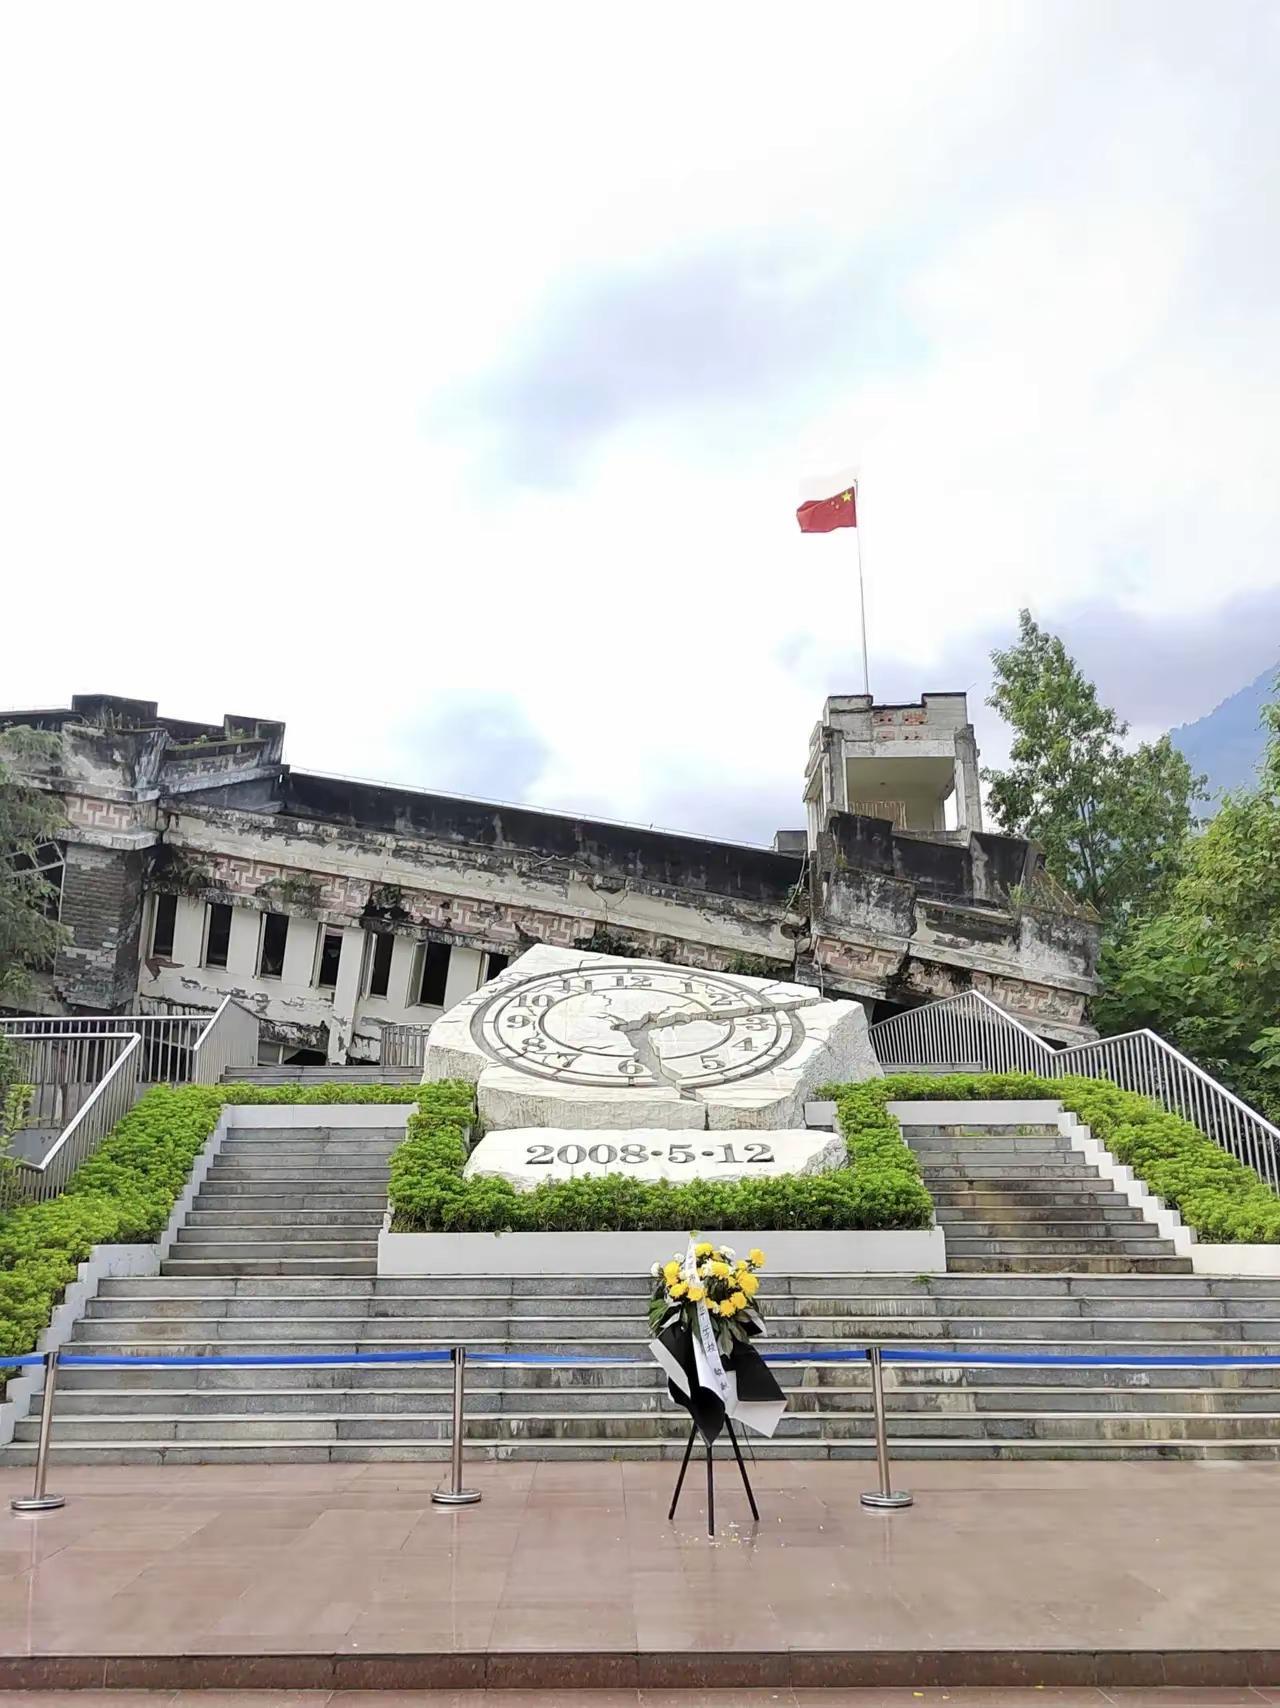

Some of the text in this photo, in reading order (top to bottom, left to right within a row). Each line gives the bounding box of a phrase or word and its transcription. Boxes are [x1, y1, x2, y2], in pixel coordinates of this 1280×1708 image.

[557, 979, 594, 993] 11
[611, 975, 653, 988] 12
[679, 980, 699, 994] 1
[511, 994, 555, 1008] 10
[708, 992, 732, 1006] 2
[506, 1014, 531, 1028] 9
[746, 1016, 770, 1031] 3
[521, 1036, 547, 1052] 8
[731, 1036, 759, 1051] 4
[542, 1052, 583, 1068] 7
[617, 1059, 644, 1075] 6
[701, 1053, 726, 1070] 5
